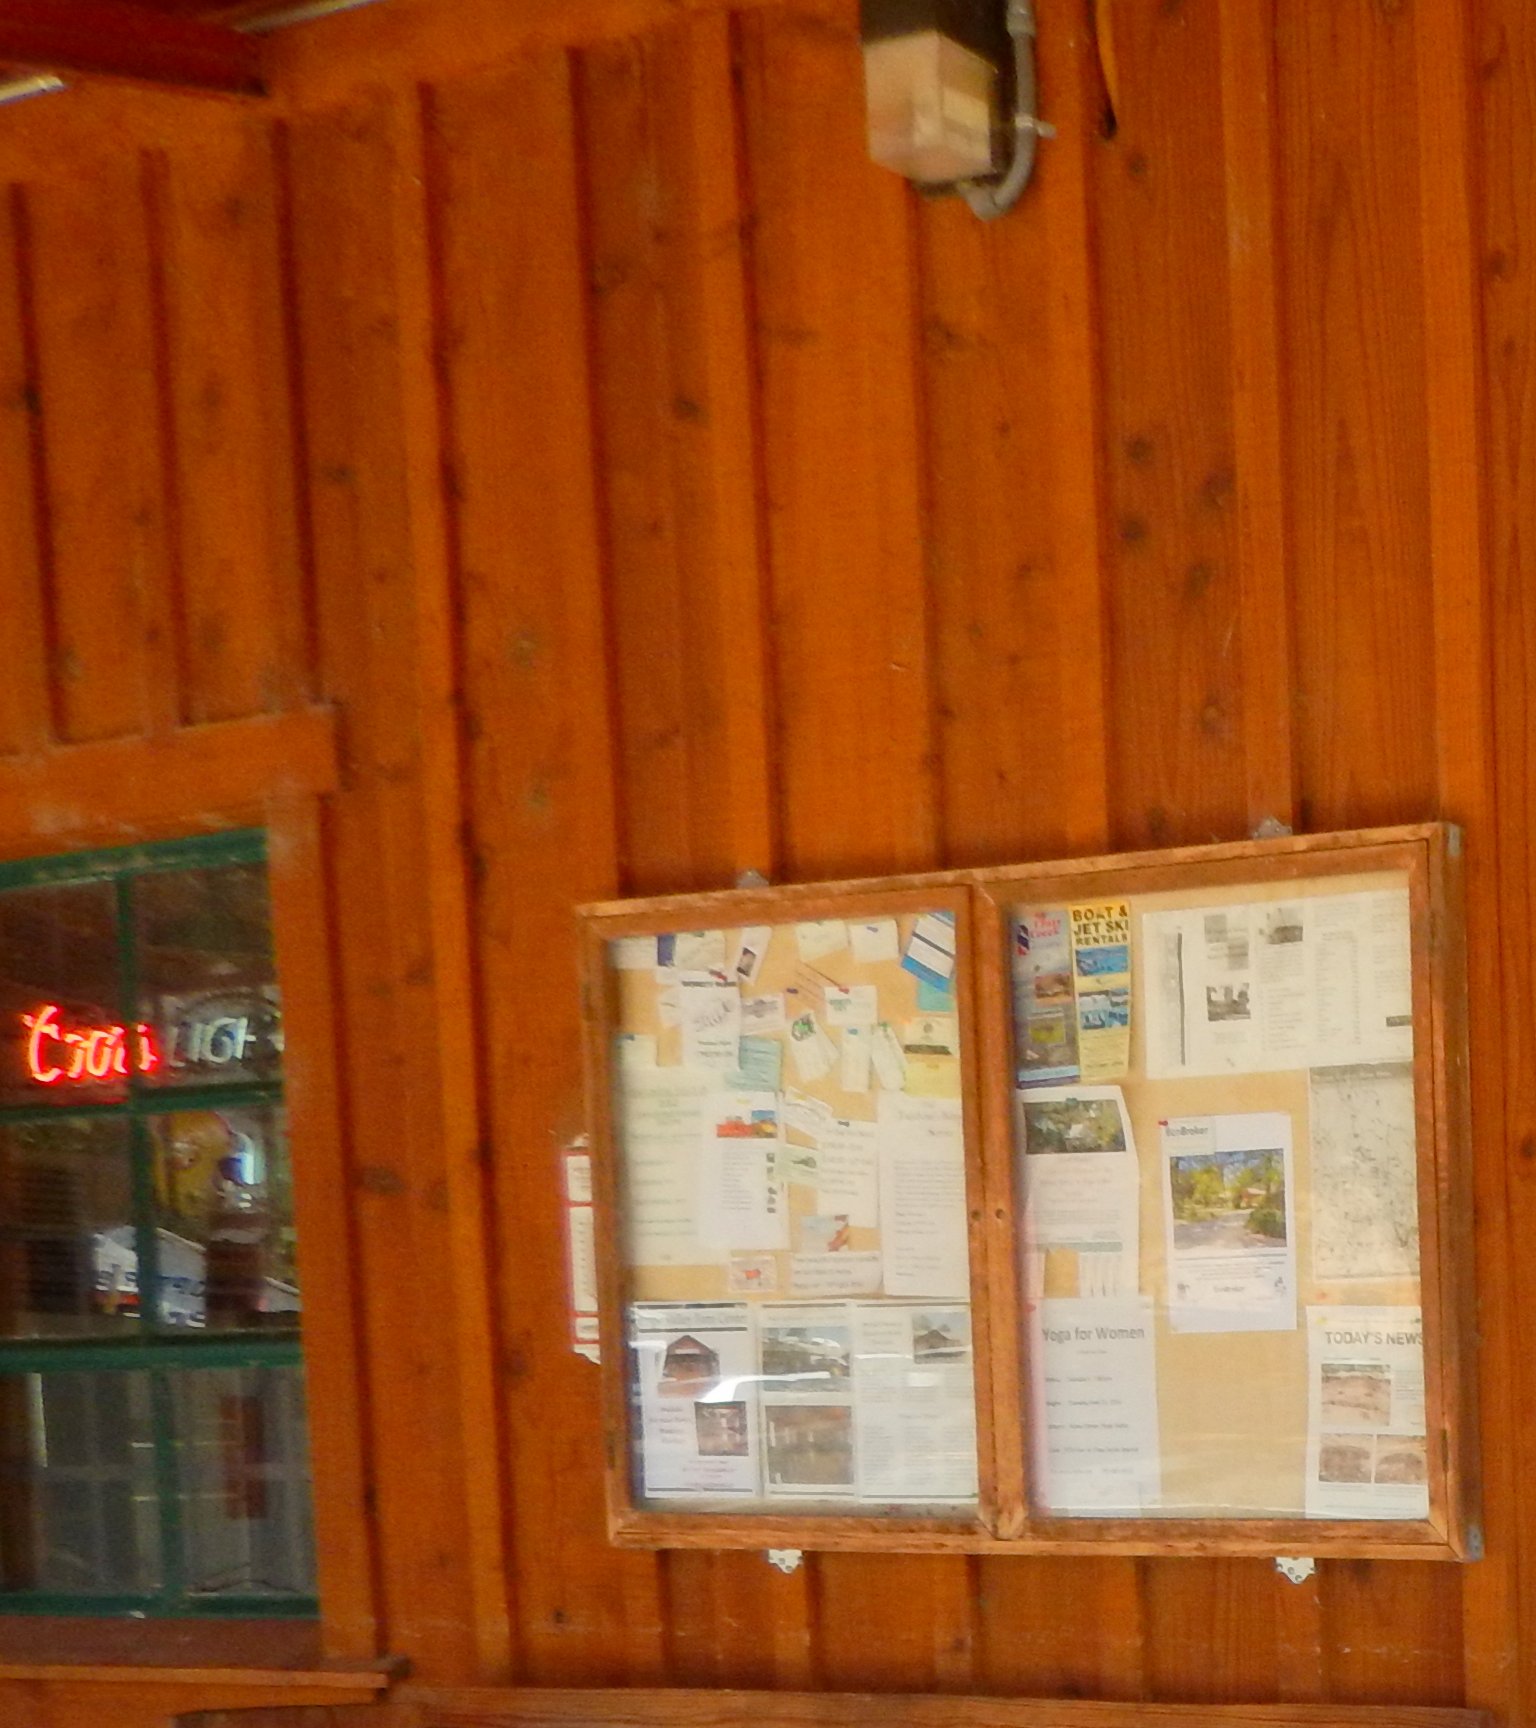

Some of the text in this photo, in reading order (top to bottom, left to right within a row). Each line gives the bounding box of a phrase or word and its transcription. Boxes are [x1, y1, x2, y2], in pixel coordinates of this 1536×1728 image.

[1073, 922, 1101, 936] JET
[1042, 1326, 1144, 1344] Yoga for Women
[1324, 1330, 1383, 1345] TODAY'S
